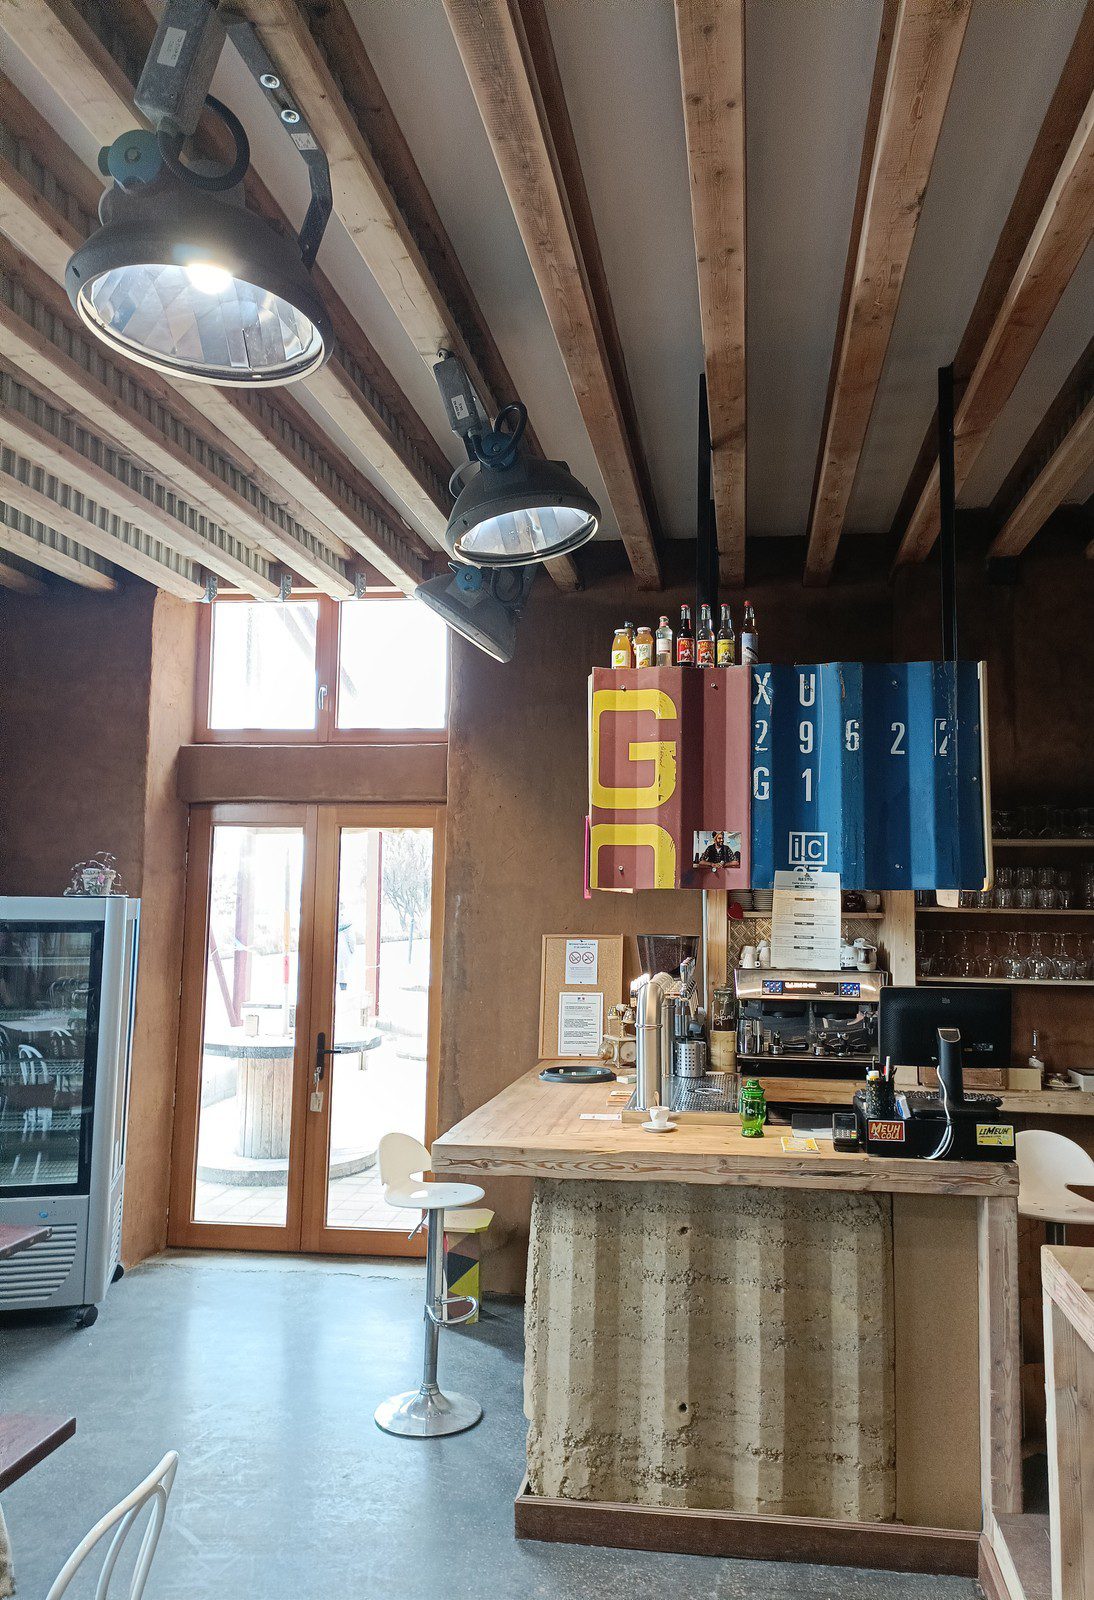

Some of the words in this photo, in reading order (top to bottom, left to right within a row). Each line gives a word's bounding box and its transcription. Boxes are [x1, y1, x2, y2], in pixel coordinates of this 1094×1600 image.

[871, 1122, 901, 1133] MEUH
[979, 1126, 1009, 1136] LIMEUH
[881, 1132, 900, 1140] COLA
